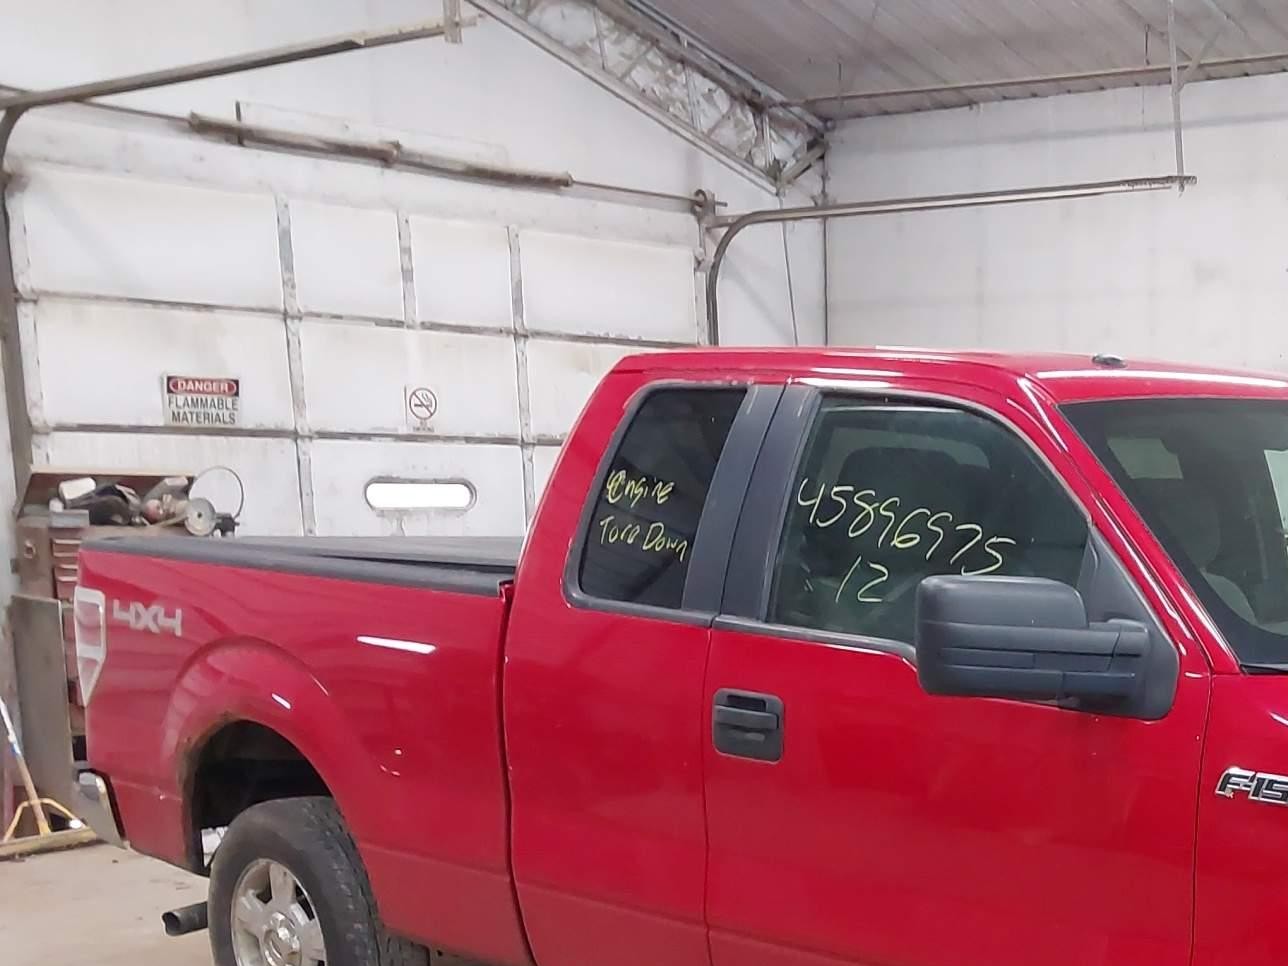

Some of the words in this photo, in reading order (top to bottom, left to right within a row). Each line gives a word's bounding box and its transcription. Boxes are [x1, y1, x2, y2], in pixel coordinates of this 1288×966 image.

[177, 379, 229, 393] DANGER
[167, 395, 239, 411] FLAMMABLE
[171, 410, 236, 425] MATERIALS
[797, 478, 1017, 577] 45896975
[642, 522, 688, 563] Down
[835, 555, 889, 603] 12
